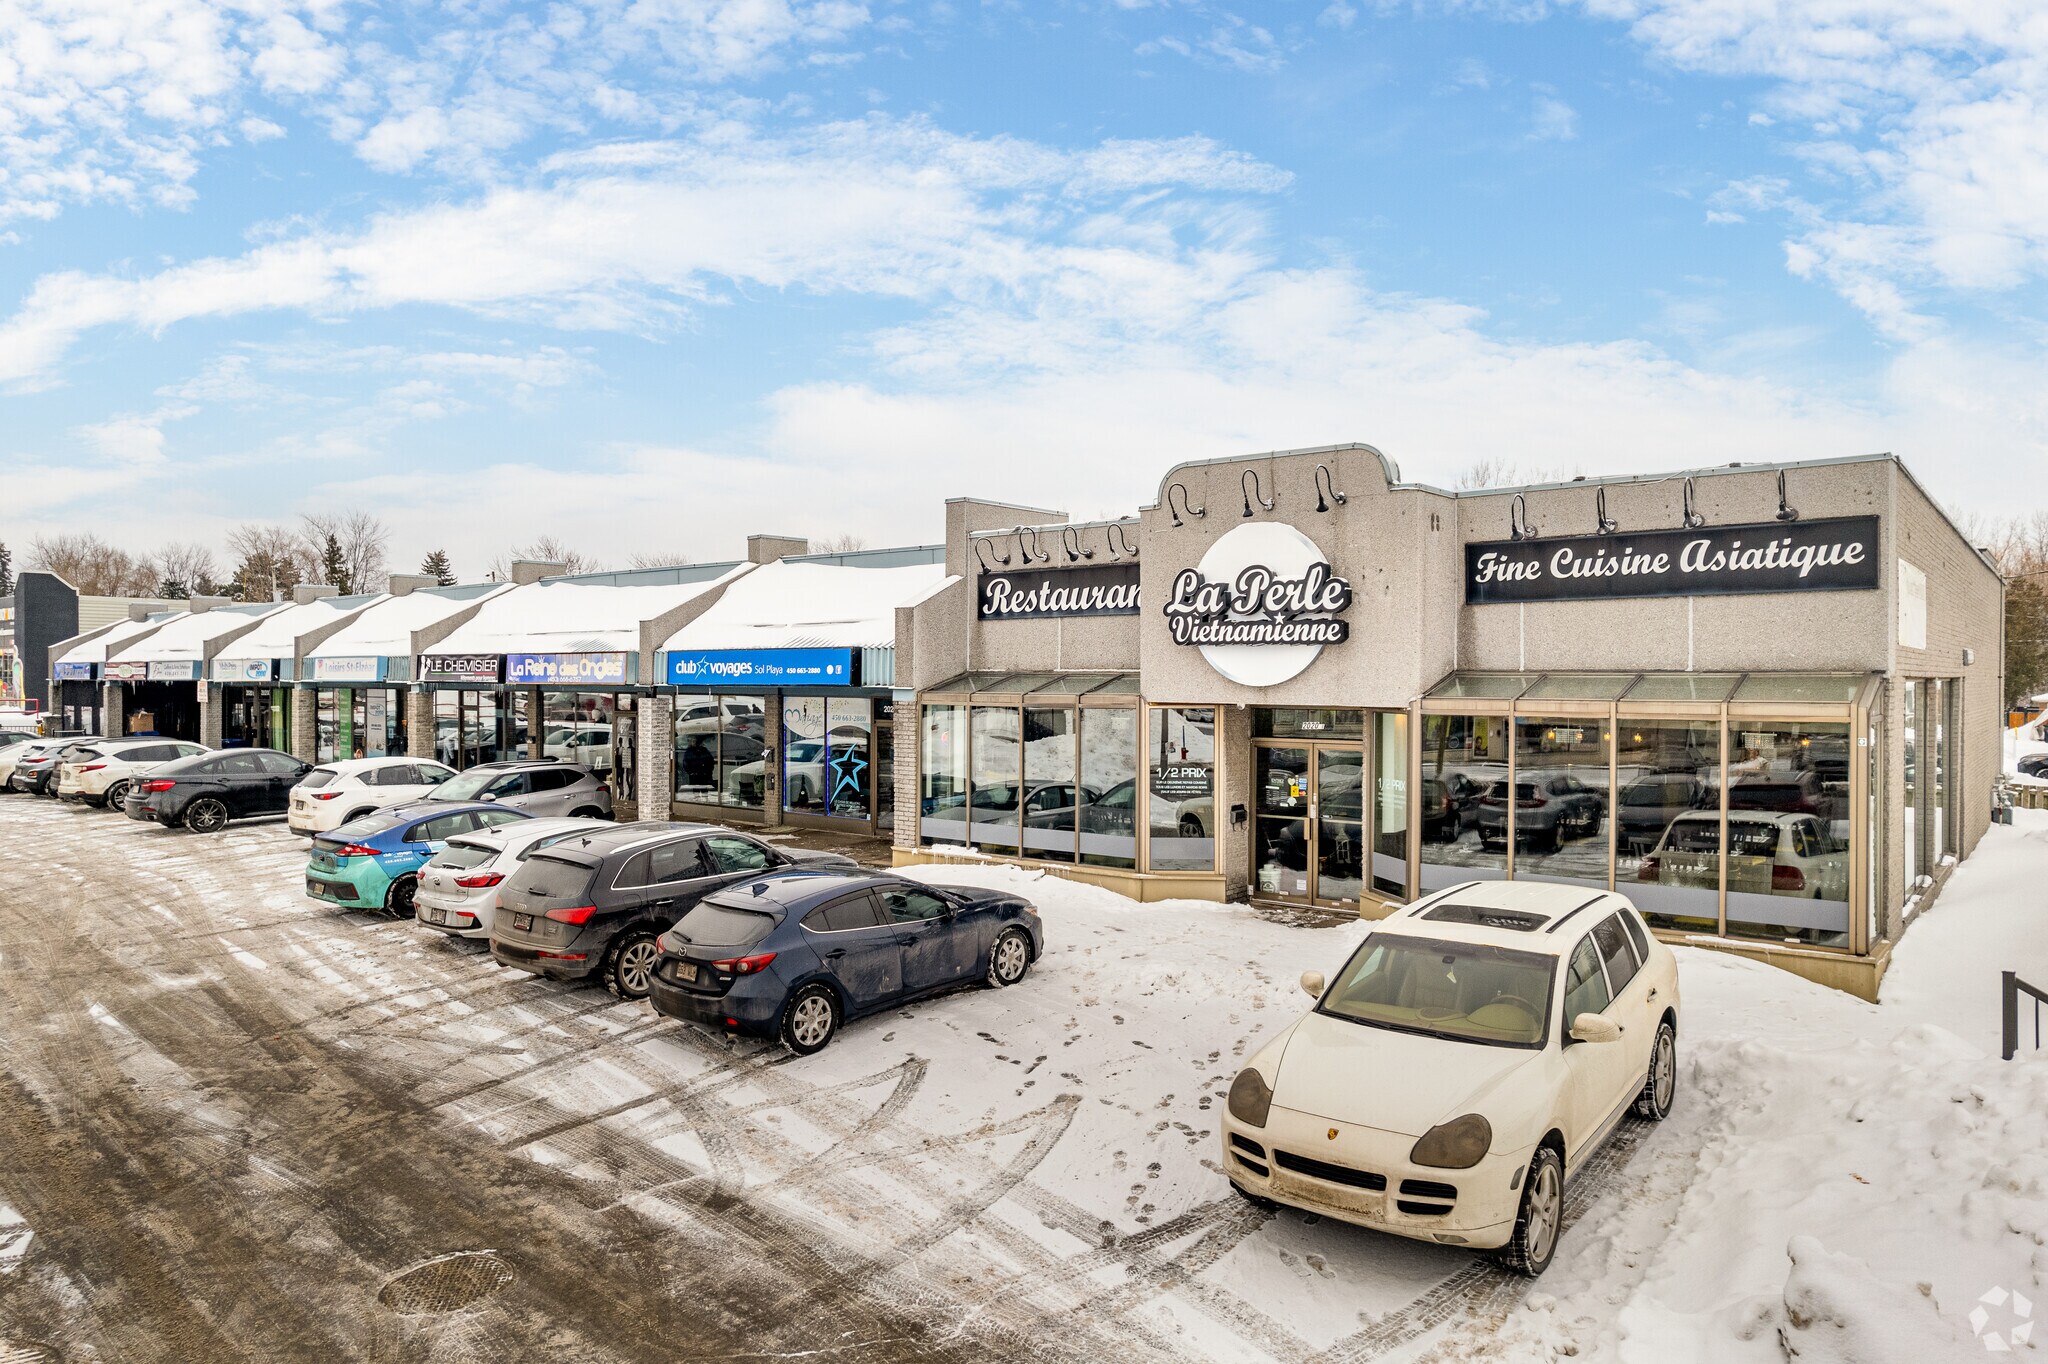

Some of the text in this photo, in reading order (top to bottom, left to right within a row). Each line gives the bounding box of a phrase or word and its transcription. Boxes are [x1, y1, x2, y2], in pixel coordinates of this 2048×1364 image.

[1475, 537, 1865, 583] Fine Cuisine Asiatique
[982, 578, 1140, 615] Restauran
[1166, 565, 1345, 615] La Perle
[1171, 612, 1341, 643] Vietnamienne
[325, 661, 345, 672] Loisirs
[430, 659, 498, 672] LE CHEMISIER
[510, 657, 623, 680] La Reine des Ongles
[676, 660, 696, 674] club
[709, 661, 752, 677] voyages
[755, 666, 764, 674] Sol
[766, 665, 783, 676] Playa
[883, 705, 894, 713] 202
[1156, 767, 1207, 780] 1/2 PRIX
